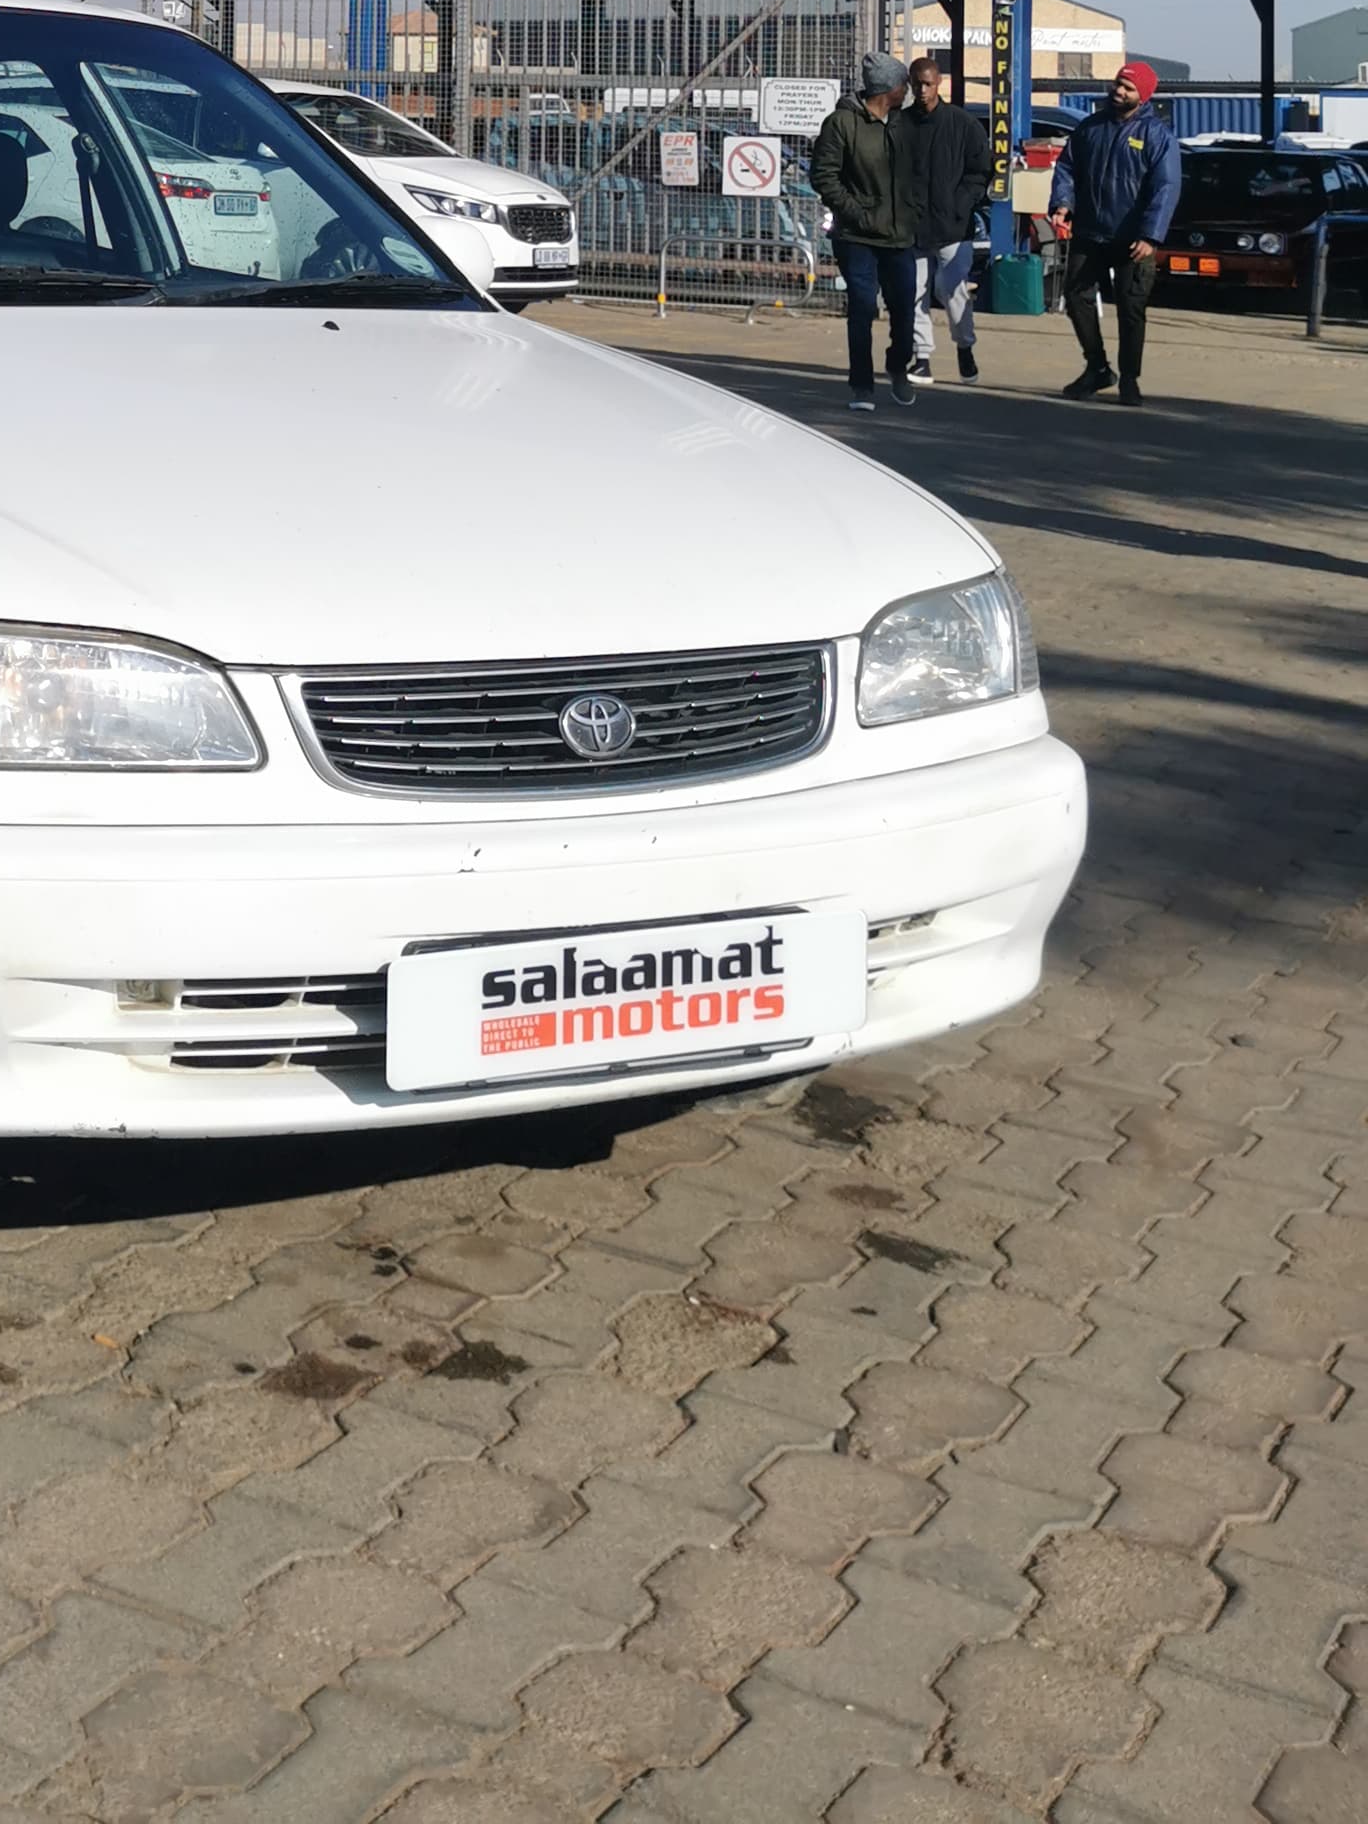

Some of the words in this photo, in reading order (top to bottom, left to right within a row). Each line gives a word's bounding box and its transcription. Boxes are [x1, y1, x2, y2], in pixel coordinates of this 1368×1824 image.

[994, 20, 1010, 51] NO
[993, 60, 1010, 194] FINANCE
[663, 135, 695, 146] EPR
[481, 925, 785, 1011] salaamat
[483, 1016, 540, 1031] WHOLESALE
[562, 984, 785, 1045] motors
[483, 1029, 518, 1042] DIRECT
[521, 1027, 535, 1037] TO
[483, 1042, 501, 1053] THE
[504, 1037, 540, 1051] PUBLIC
